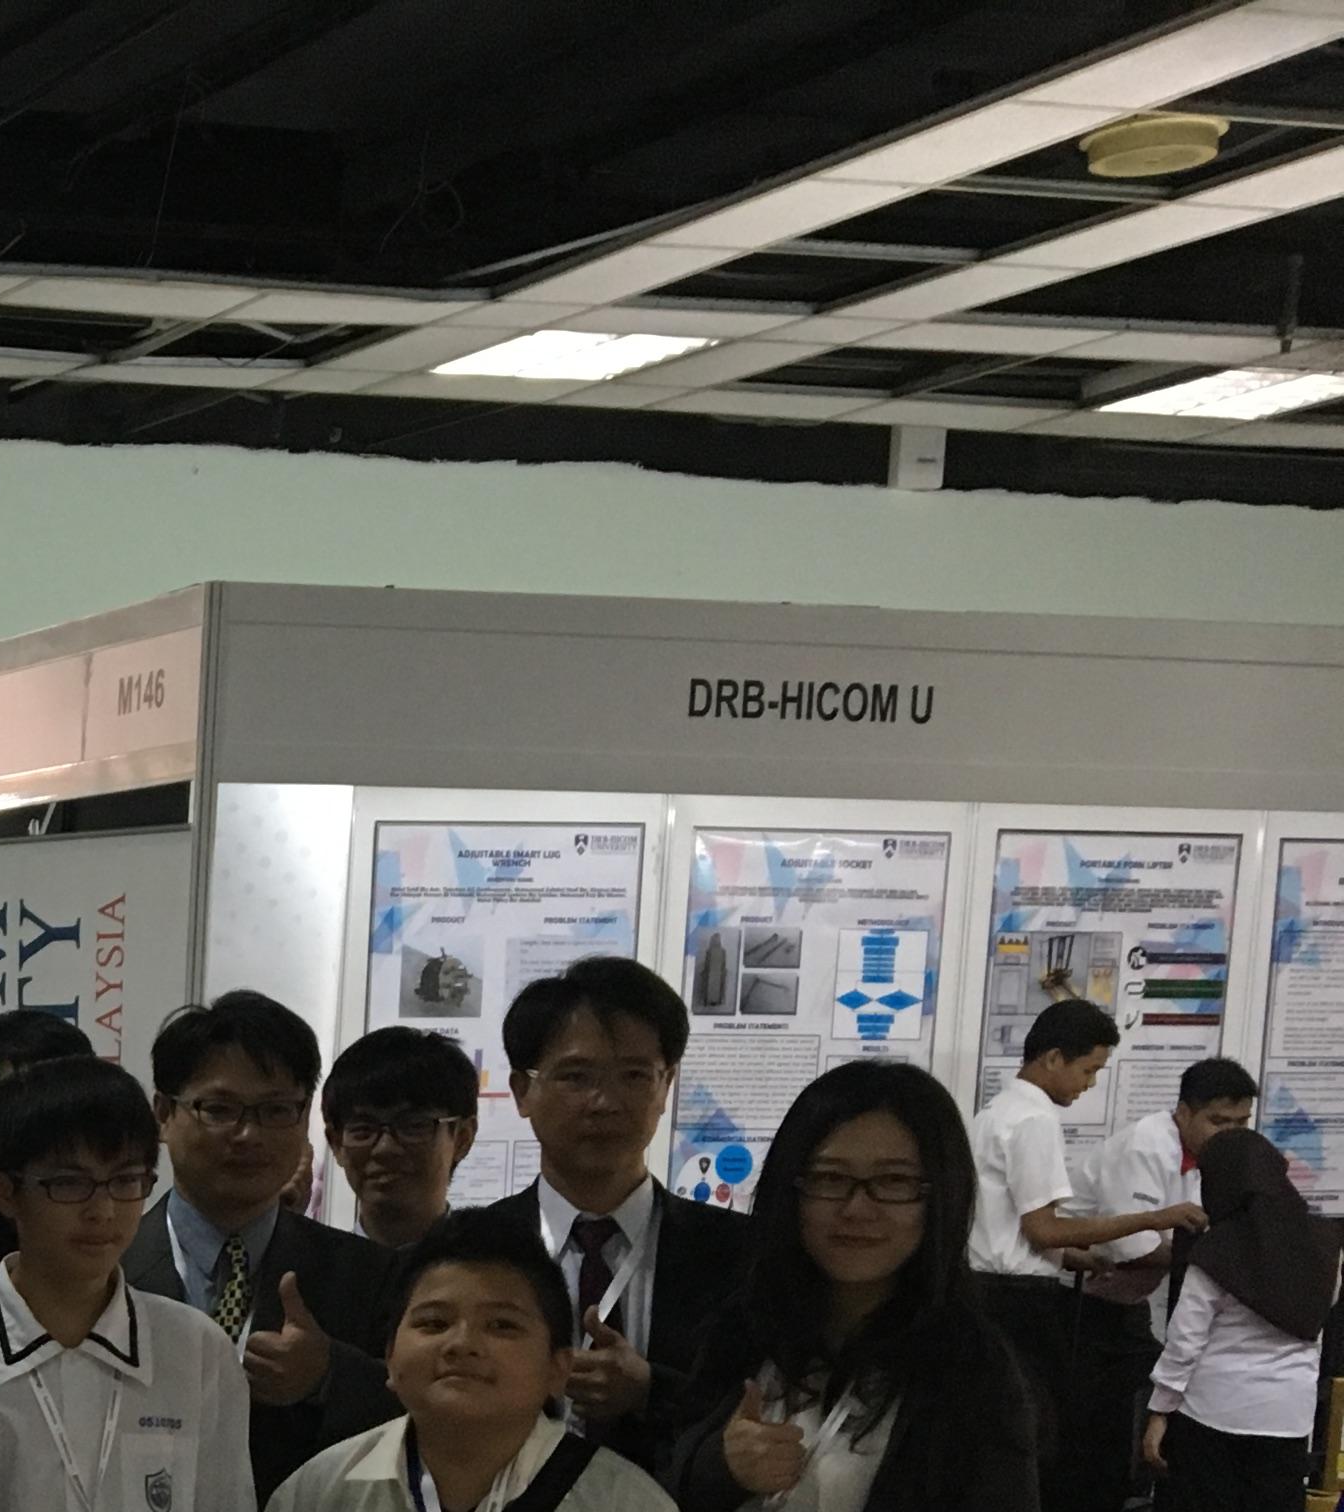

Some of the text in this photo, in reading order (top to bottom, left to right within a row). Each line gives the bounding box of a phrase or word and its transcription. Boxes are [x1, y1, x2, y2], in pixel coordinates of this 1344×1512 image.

[117, 668, 166, 716] M146
[687, 677, 934, 725] DRB-HICOM U
